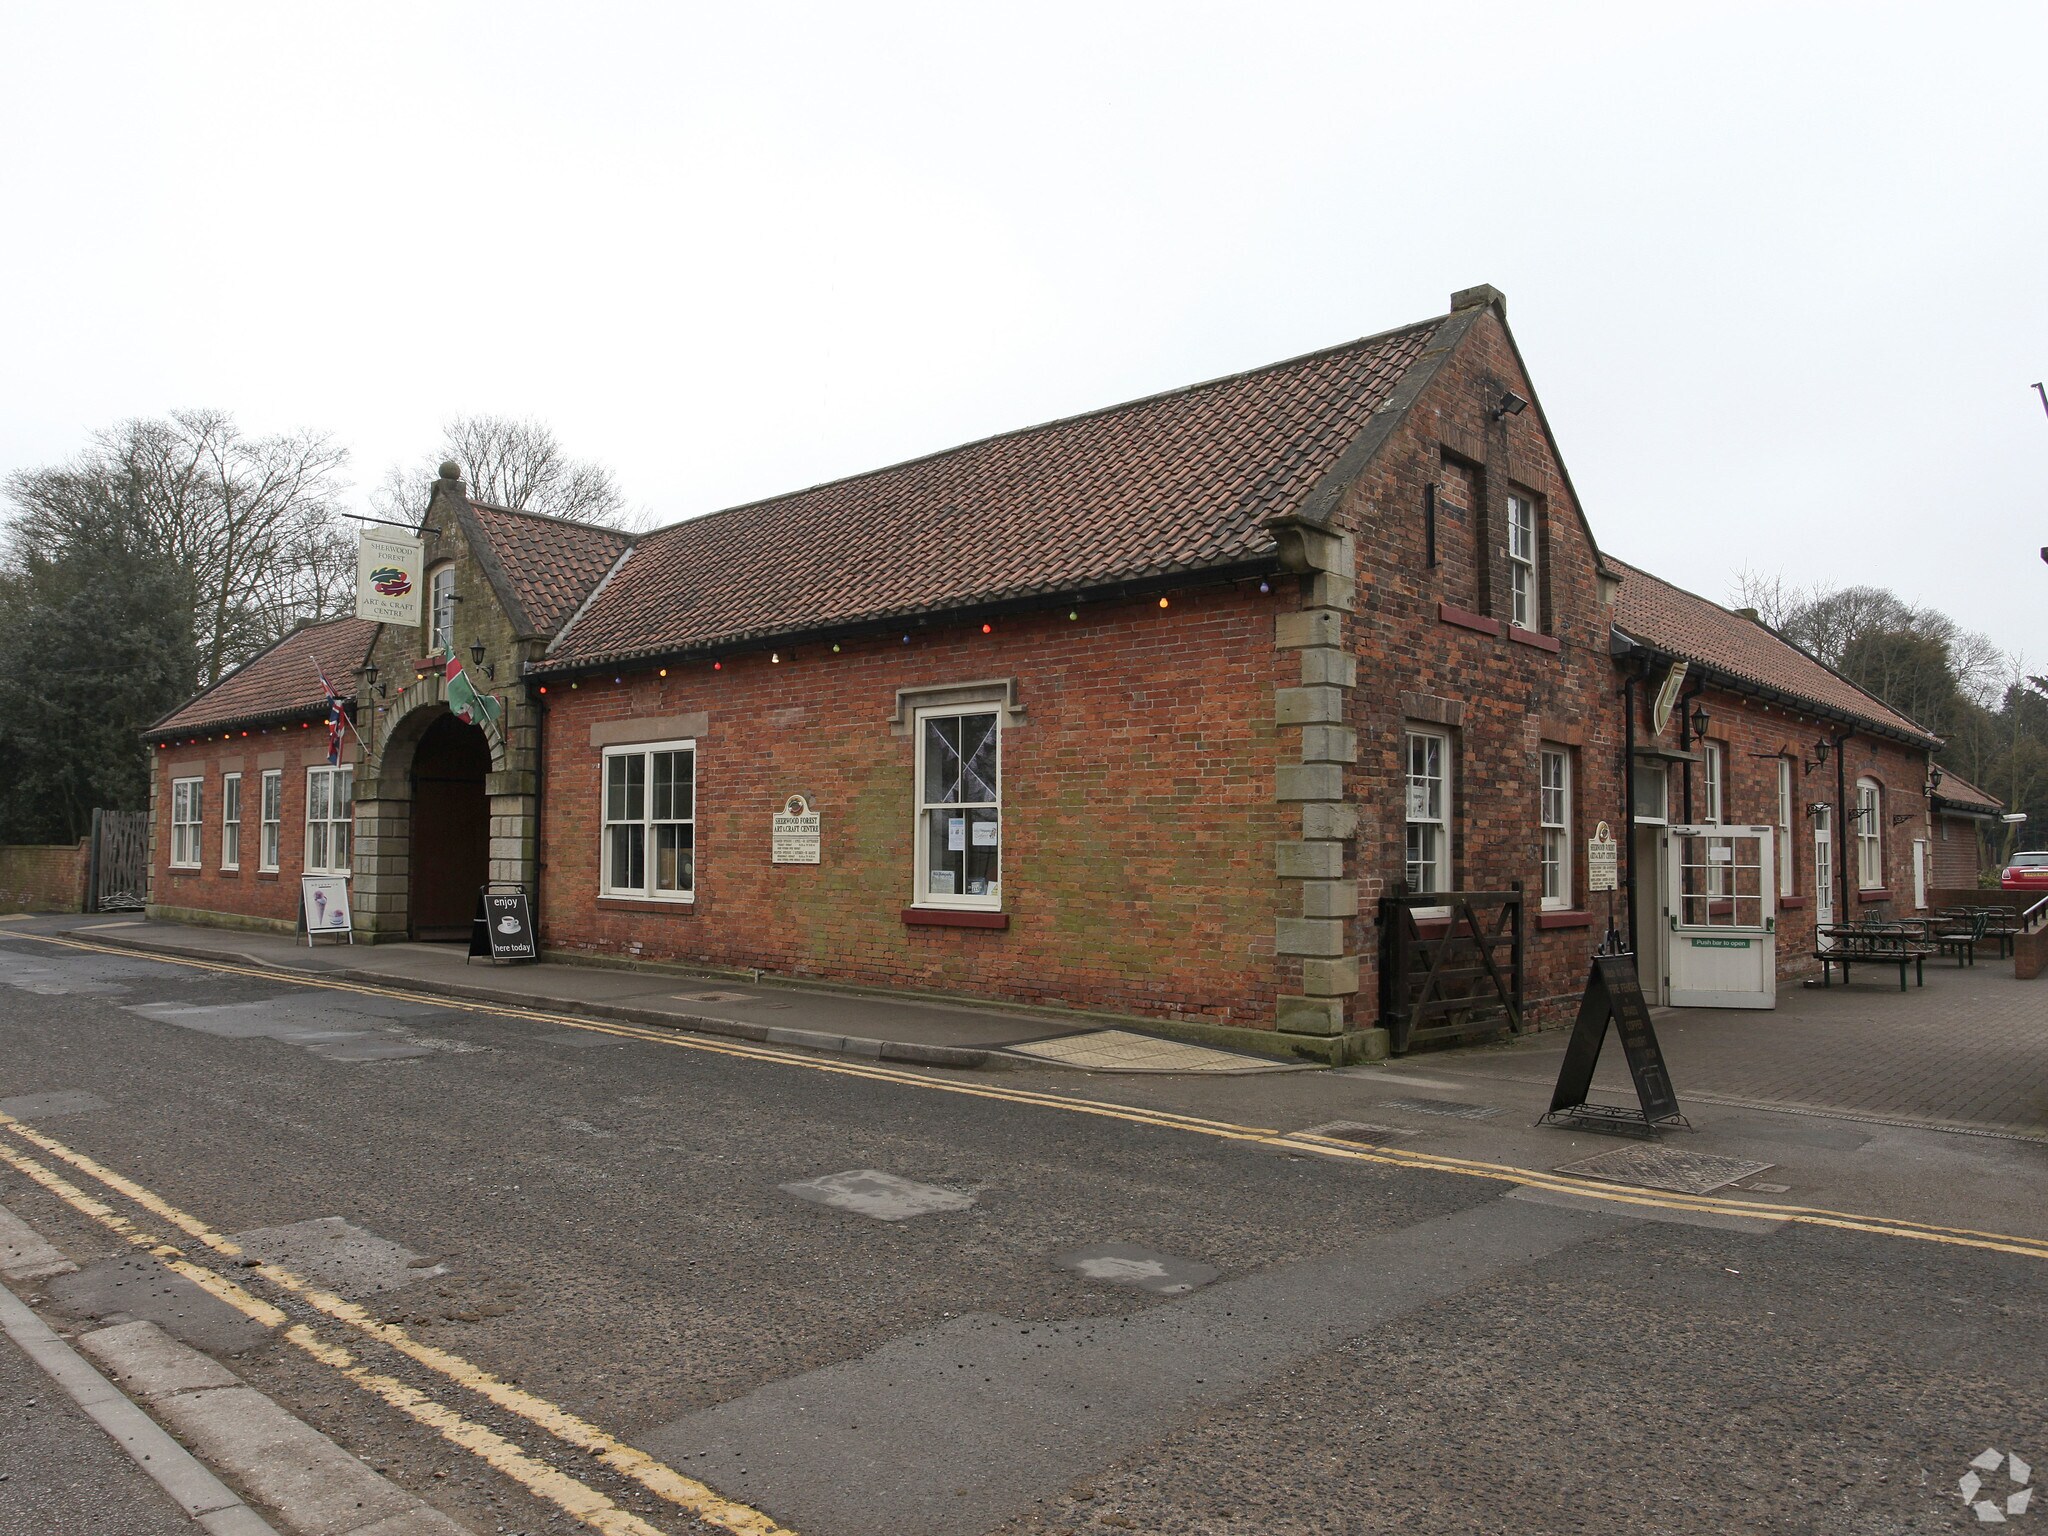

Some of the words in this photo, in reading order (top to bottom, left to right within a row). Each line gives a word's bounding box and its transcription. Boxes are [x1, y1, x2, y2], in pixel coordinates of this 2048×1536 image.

[371, 543, 412, 555] SHERWOOD
[378, 553, 405, 562] FOREST
[389, 601, 414, 611] CRAFT
[373, 608, 403, 617] CENTRE
[494, 896, 518, 909] enjoy
[511, 943, 531, 953] today
